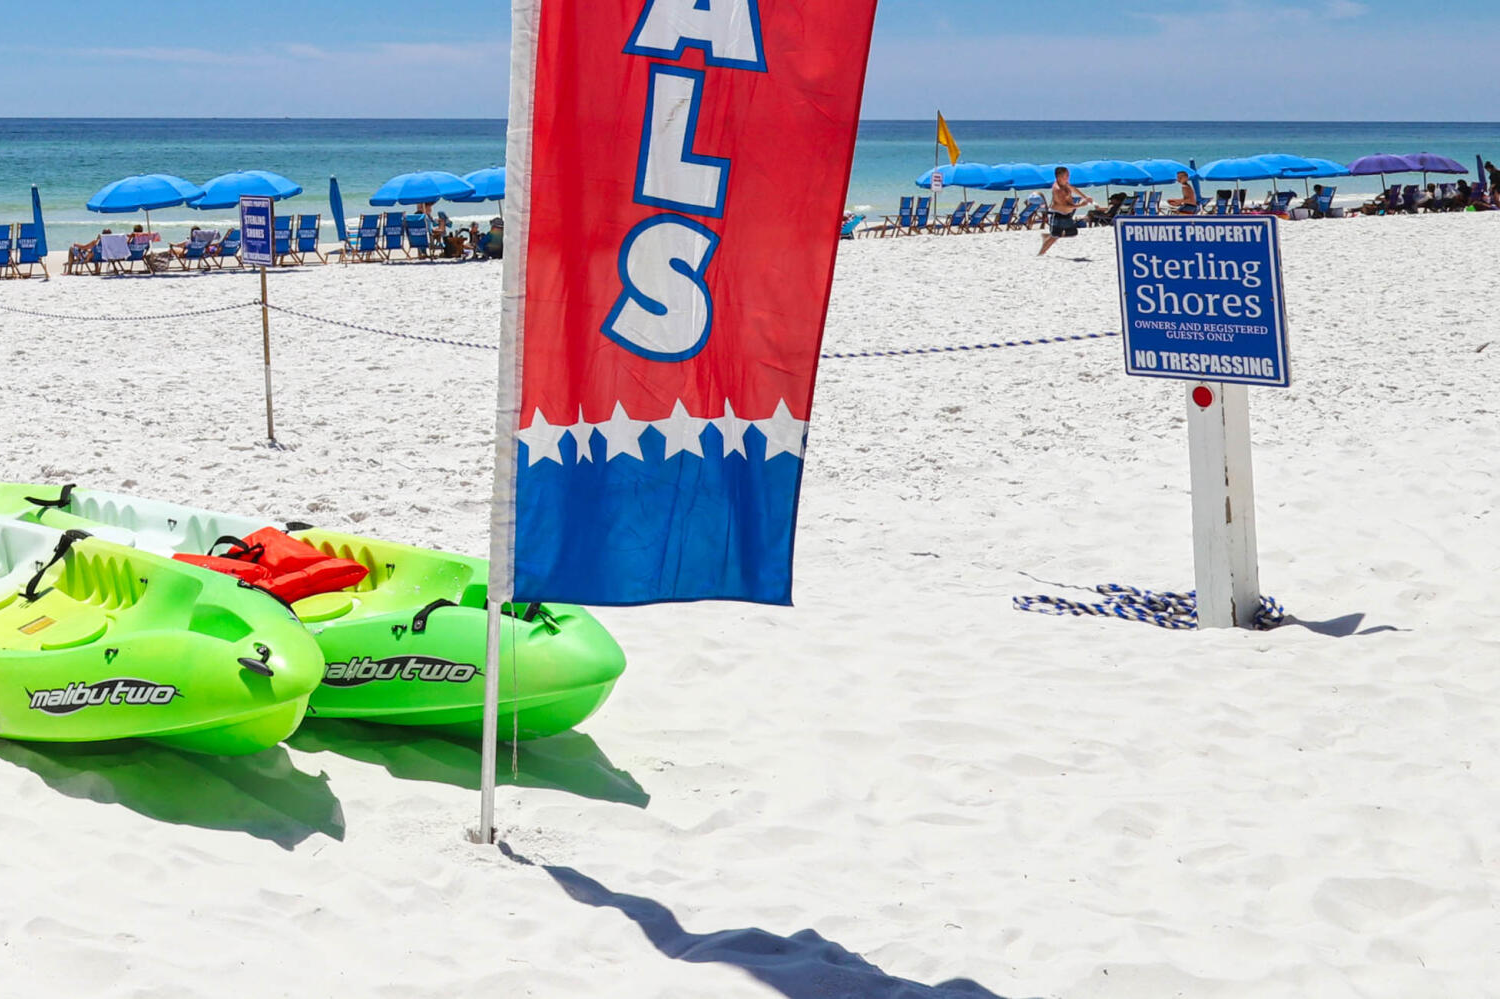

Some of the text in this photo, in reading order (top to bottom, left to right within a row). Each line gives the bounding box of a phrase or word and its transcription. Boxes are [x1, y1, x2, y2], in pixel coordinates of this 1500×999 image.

[1125, 225, 1263, 243] PRIVATE PROPERTY
[1132, 252, 1262, 288] Sterling
[1136, 283, 1262, 318] Shores
[1134, 320, 1268, 335] OWNERS AND REGISTERED
[1166, 331, 1235, 342] GUESTS ONLY
[1135, 350, 1275, 377] NO TRESPASSING
[321, 656, 477, 683] alibu two
[29, 681, 176, 708] malibu two
